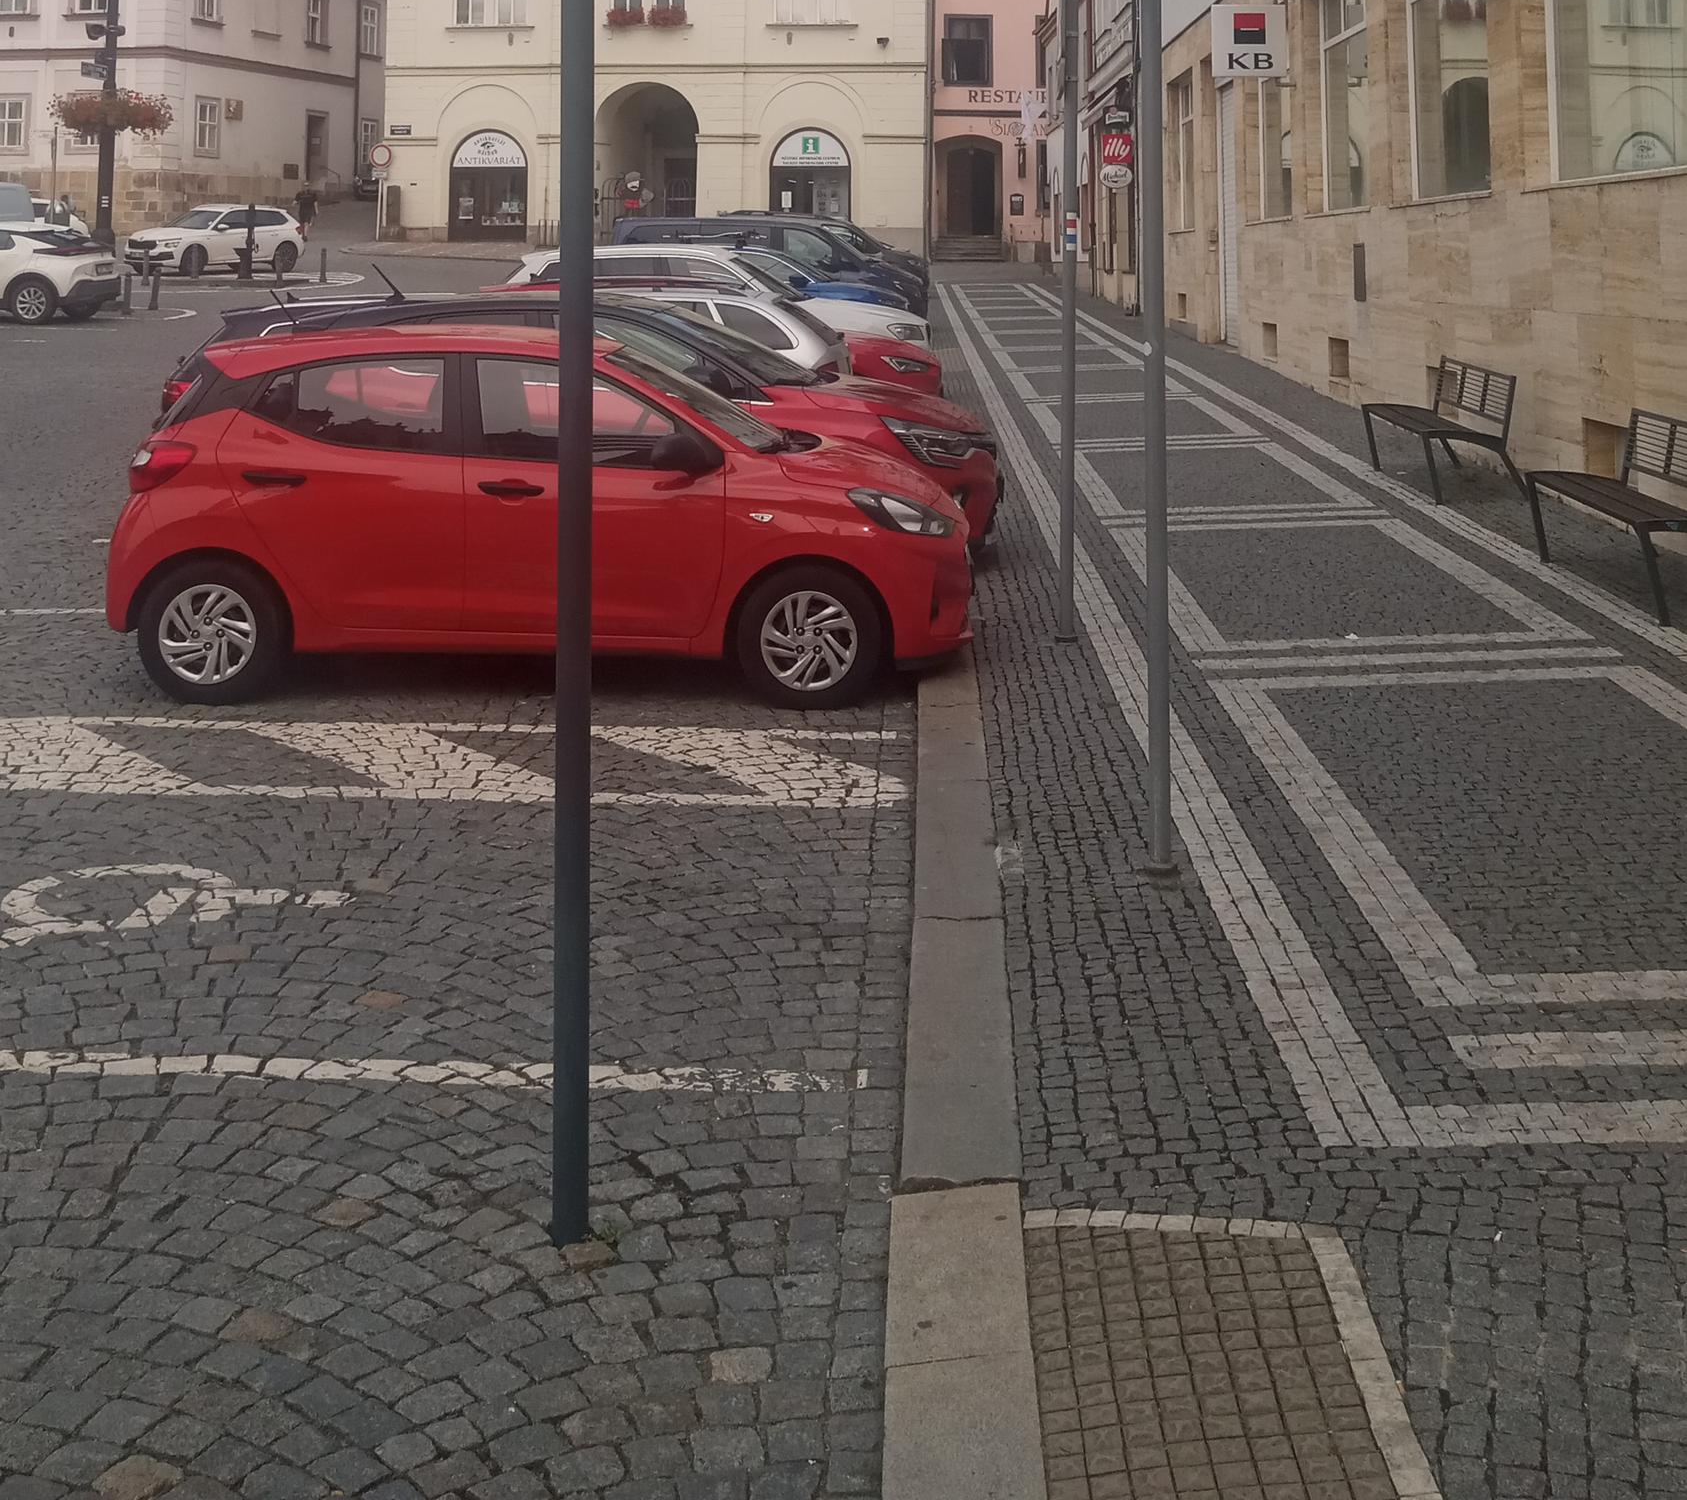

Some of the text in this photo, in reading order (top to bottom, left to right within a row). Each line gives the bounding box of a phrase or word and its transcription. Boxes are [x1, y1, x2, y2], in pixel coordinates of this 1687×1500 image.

[1227, 52, 1274, 70] KB
[1104, 137, 1131, 161] illy
[457, 156, 521, 165] ANTIKVARIÁT
